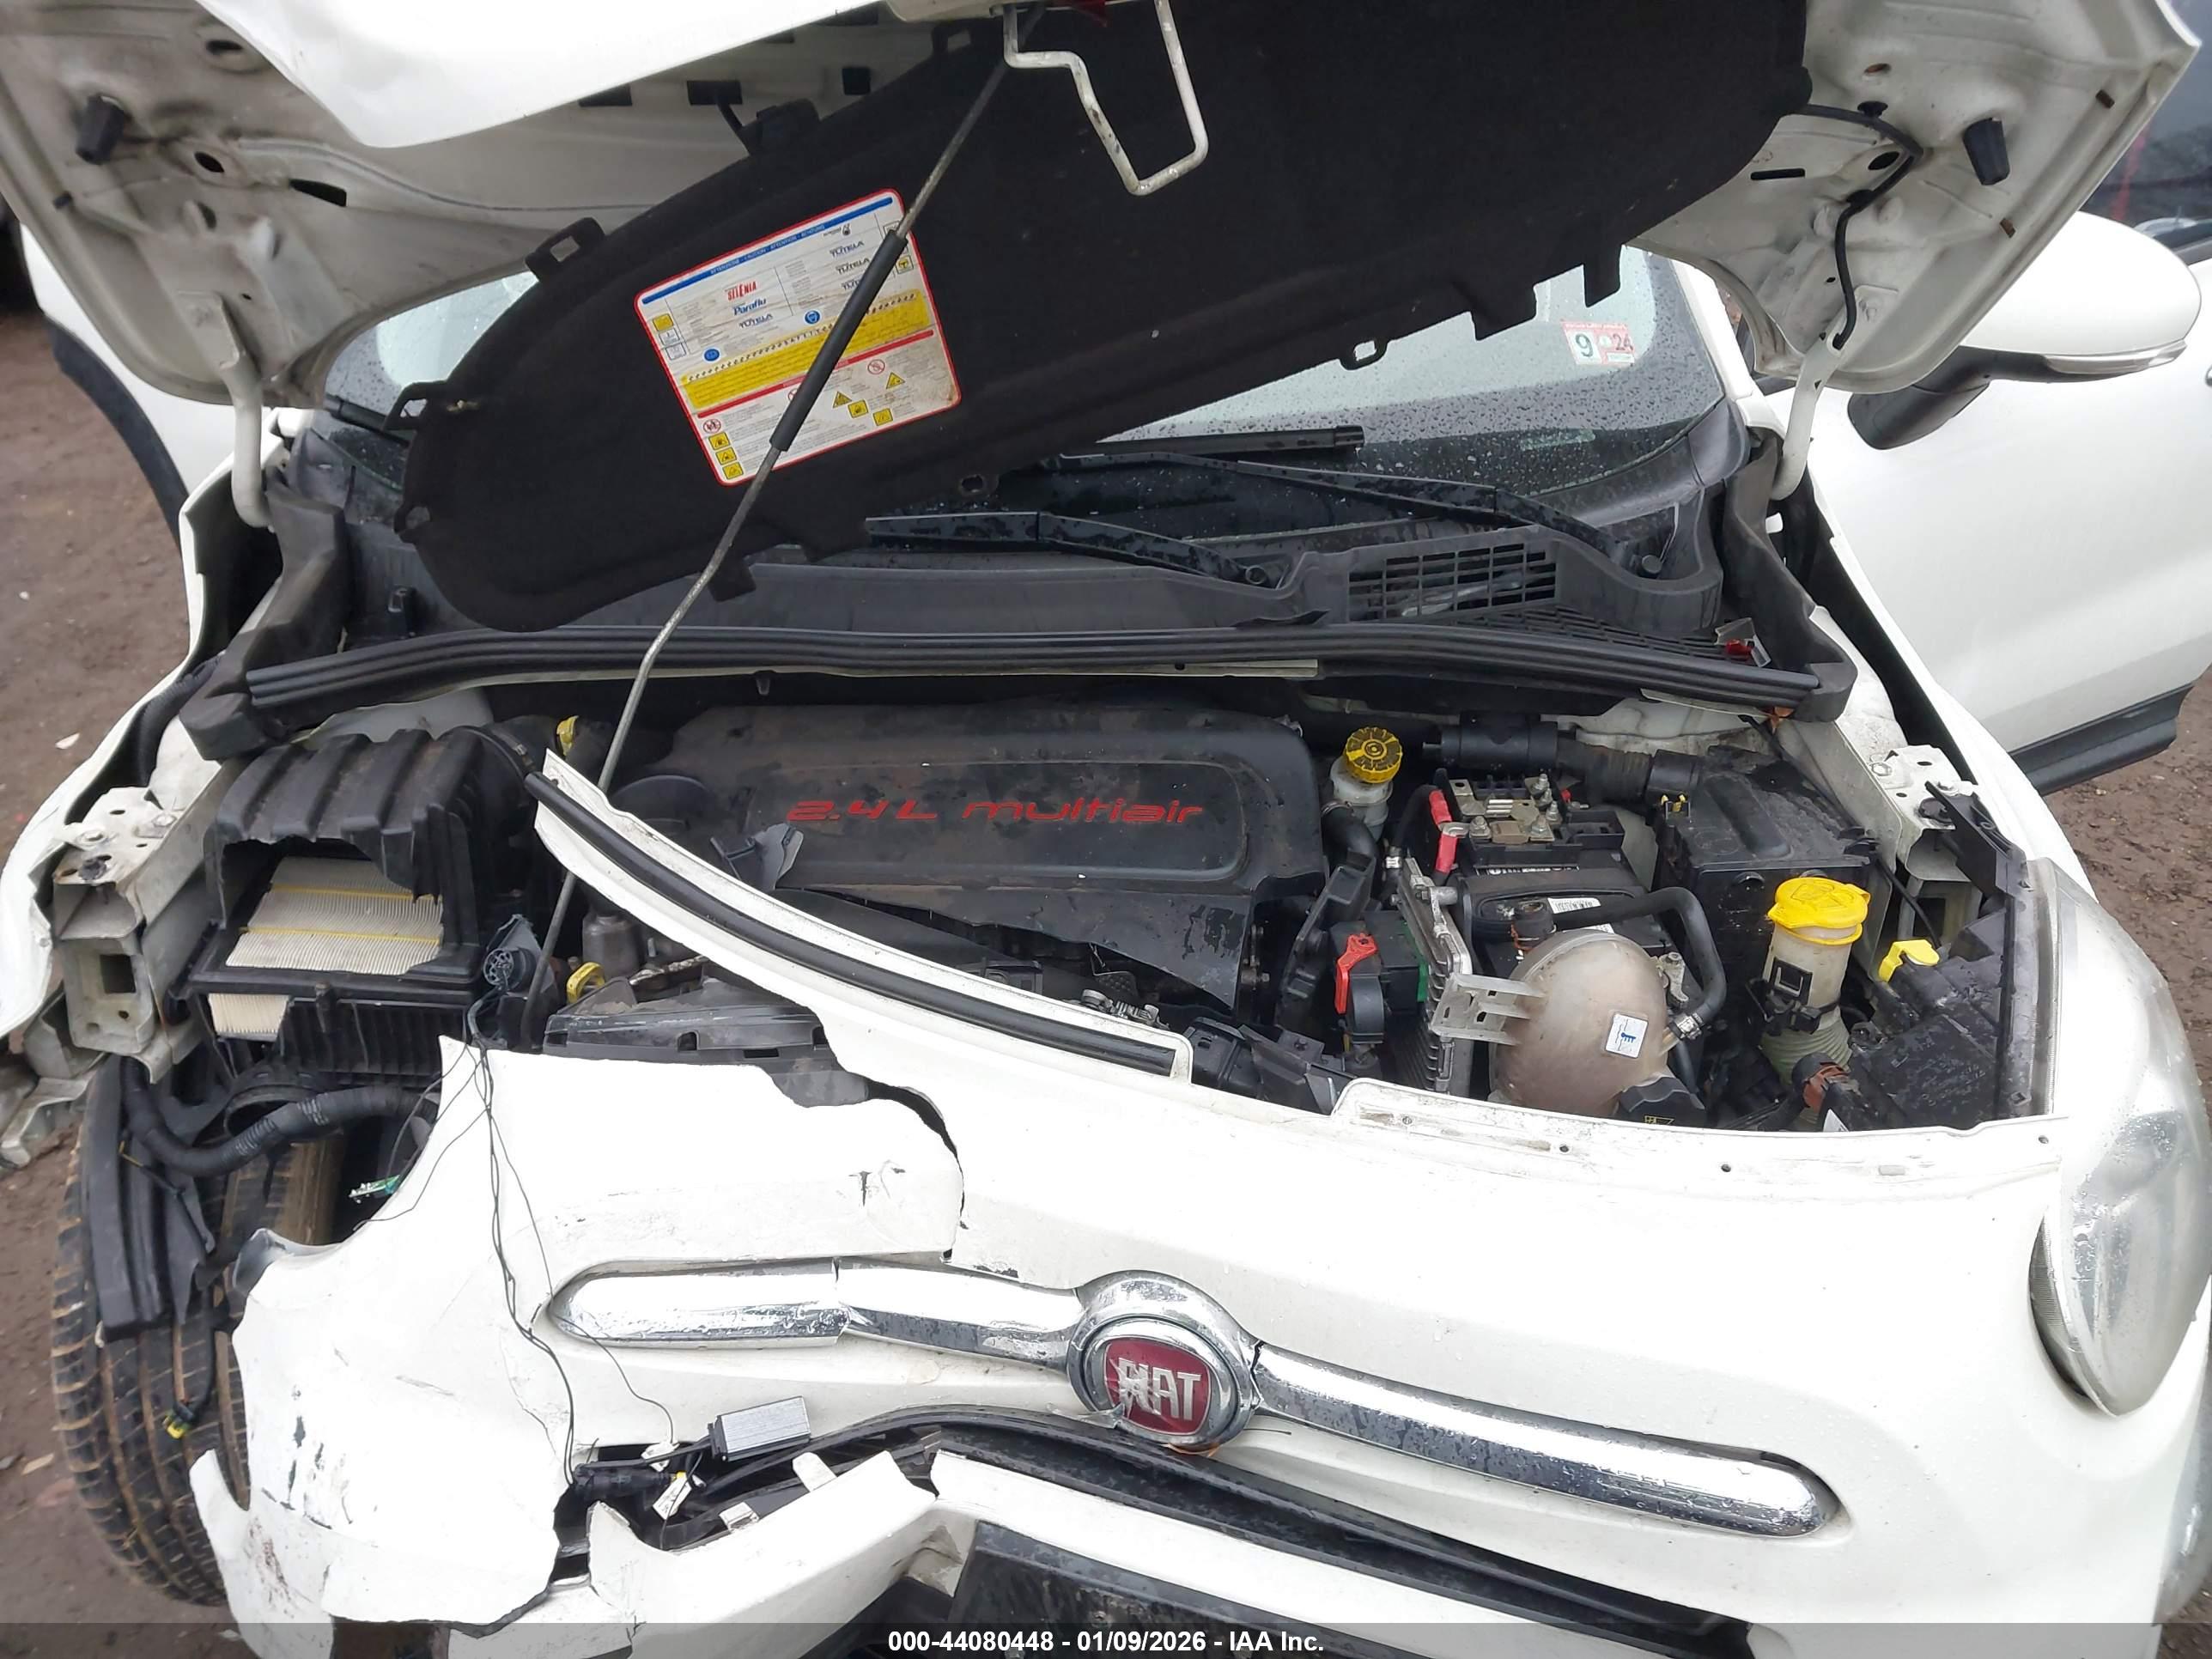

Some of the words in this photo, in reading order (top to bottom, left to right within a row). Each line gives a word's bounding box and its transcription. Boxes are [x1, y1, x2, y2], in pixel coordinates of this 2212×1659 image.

[733, 297, 767, 316] Paraflu
[1574, 332, 1595, 358] 9
[1612, 332, 1634, 352] 24
[962, 796, 1204, 823] multiair
[1116, 1357, 1202, 1422] FIAT
